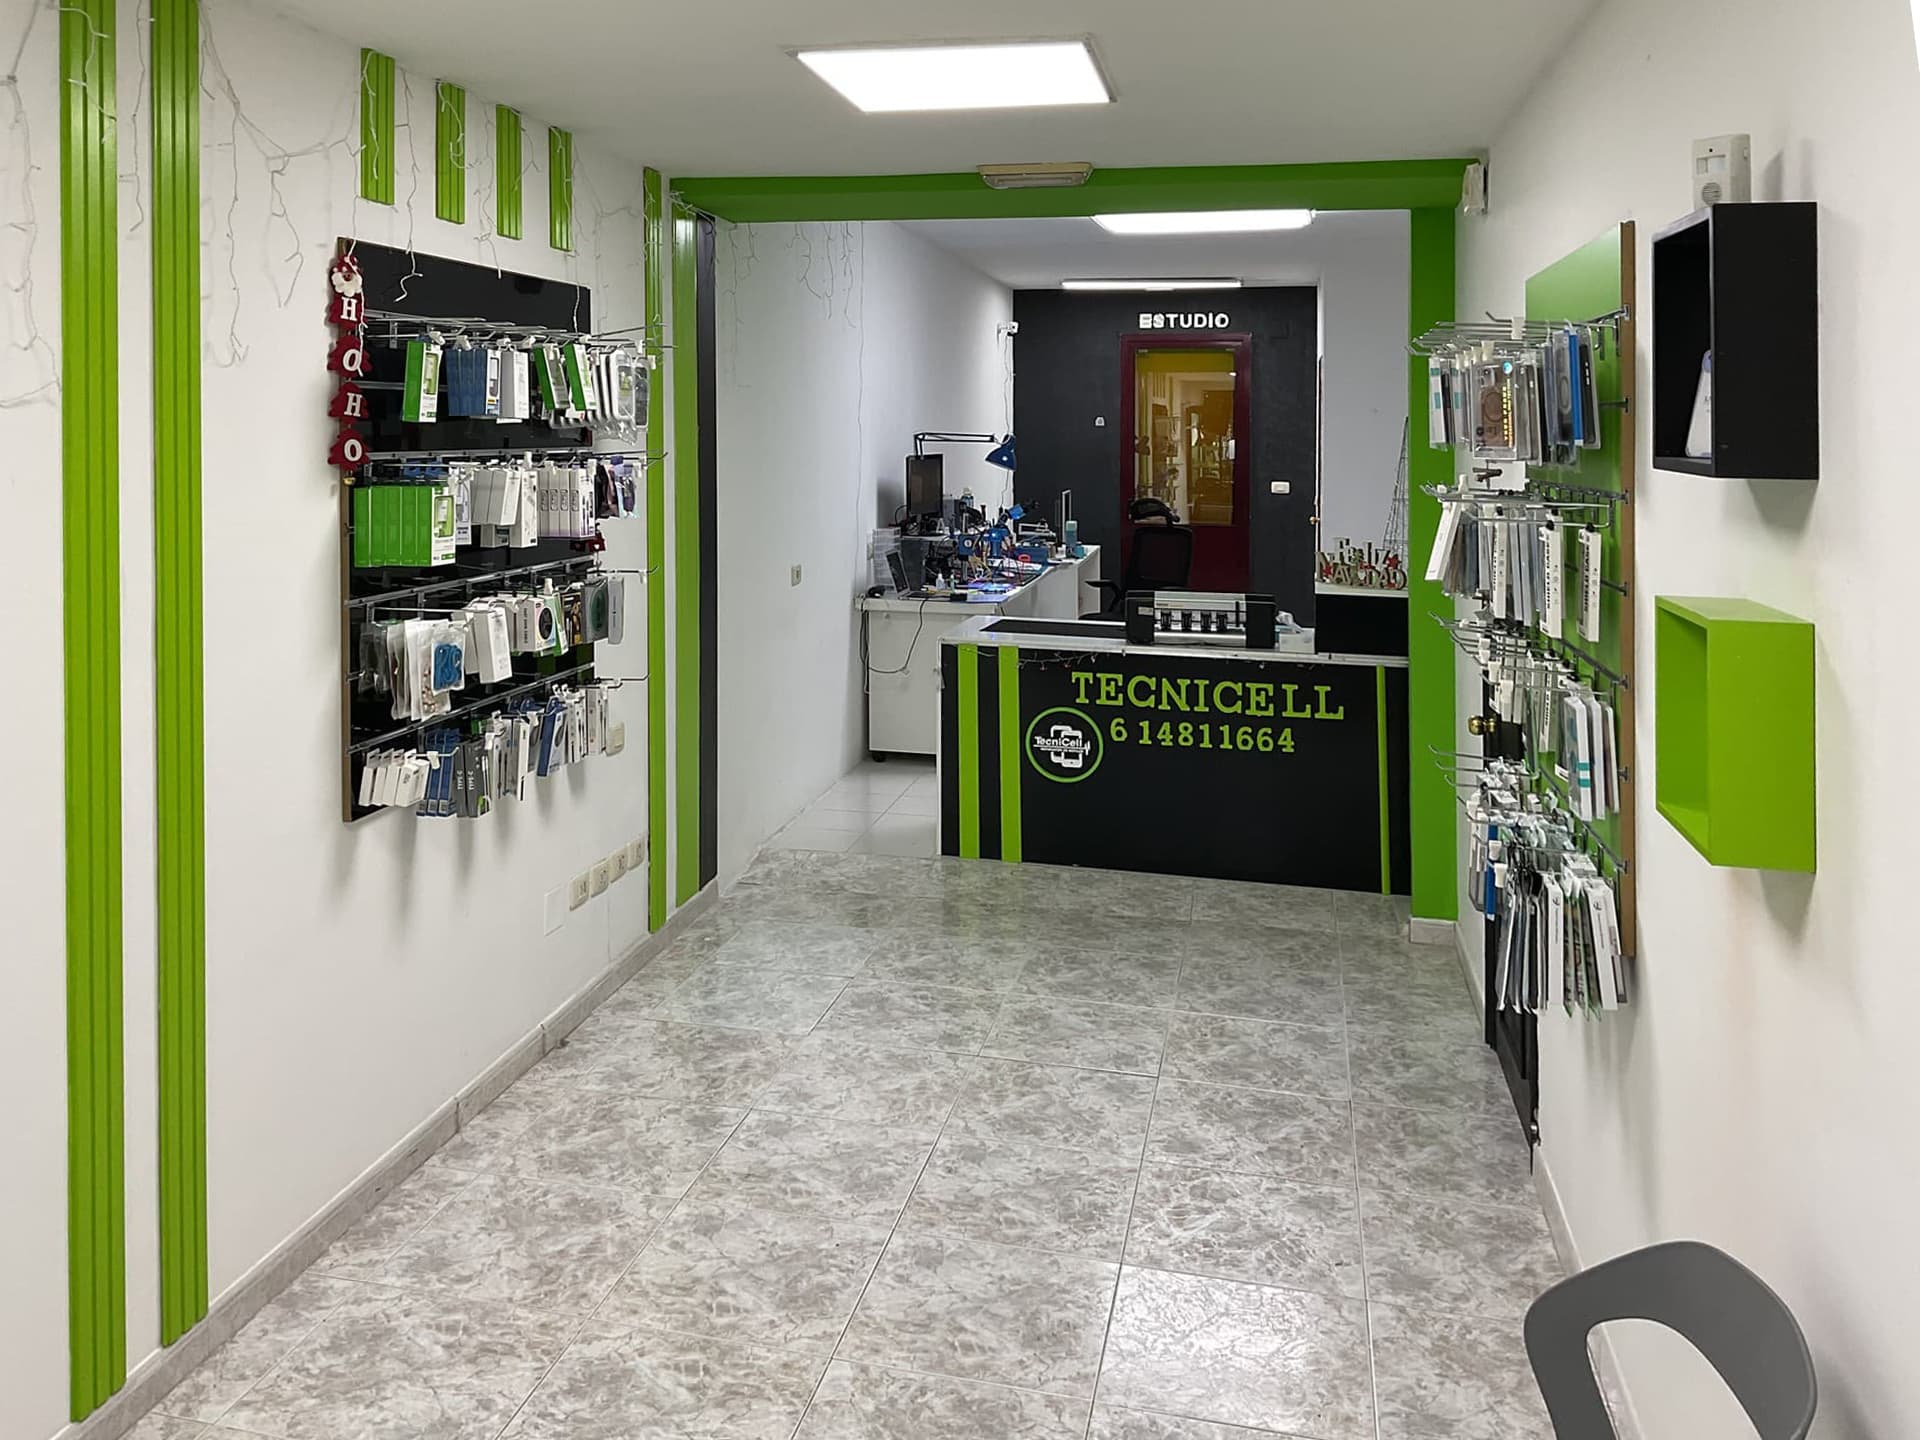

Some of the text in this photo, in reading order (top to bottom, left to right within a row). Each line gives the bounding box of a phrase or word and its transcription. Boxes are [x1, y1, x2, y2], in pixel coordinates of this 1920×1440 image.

[1139, 312, 1230, 329] ESTUDIO
[1071, 671, 1345, 720] TECNICELL
[1034, 735, 1083, 747] TecniCell
[1109, 717, 1296, 753] 6 14811664
